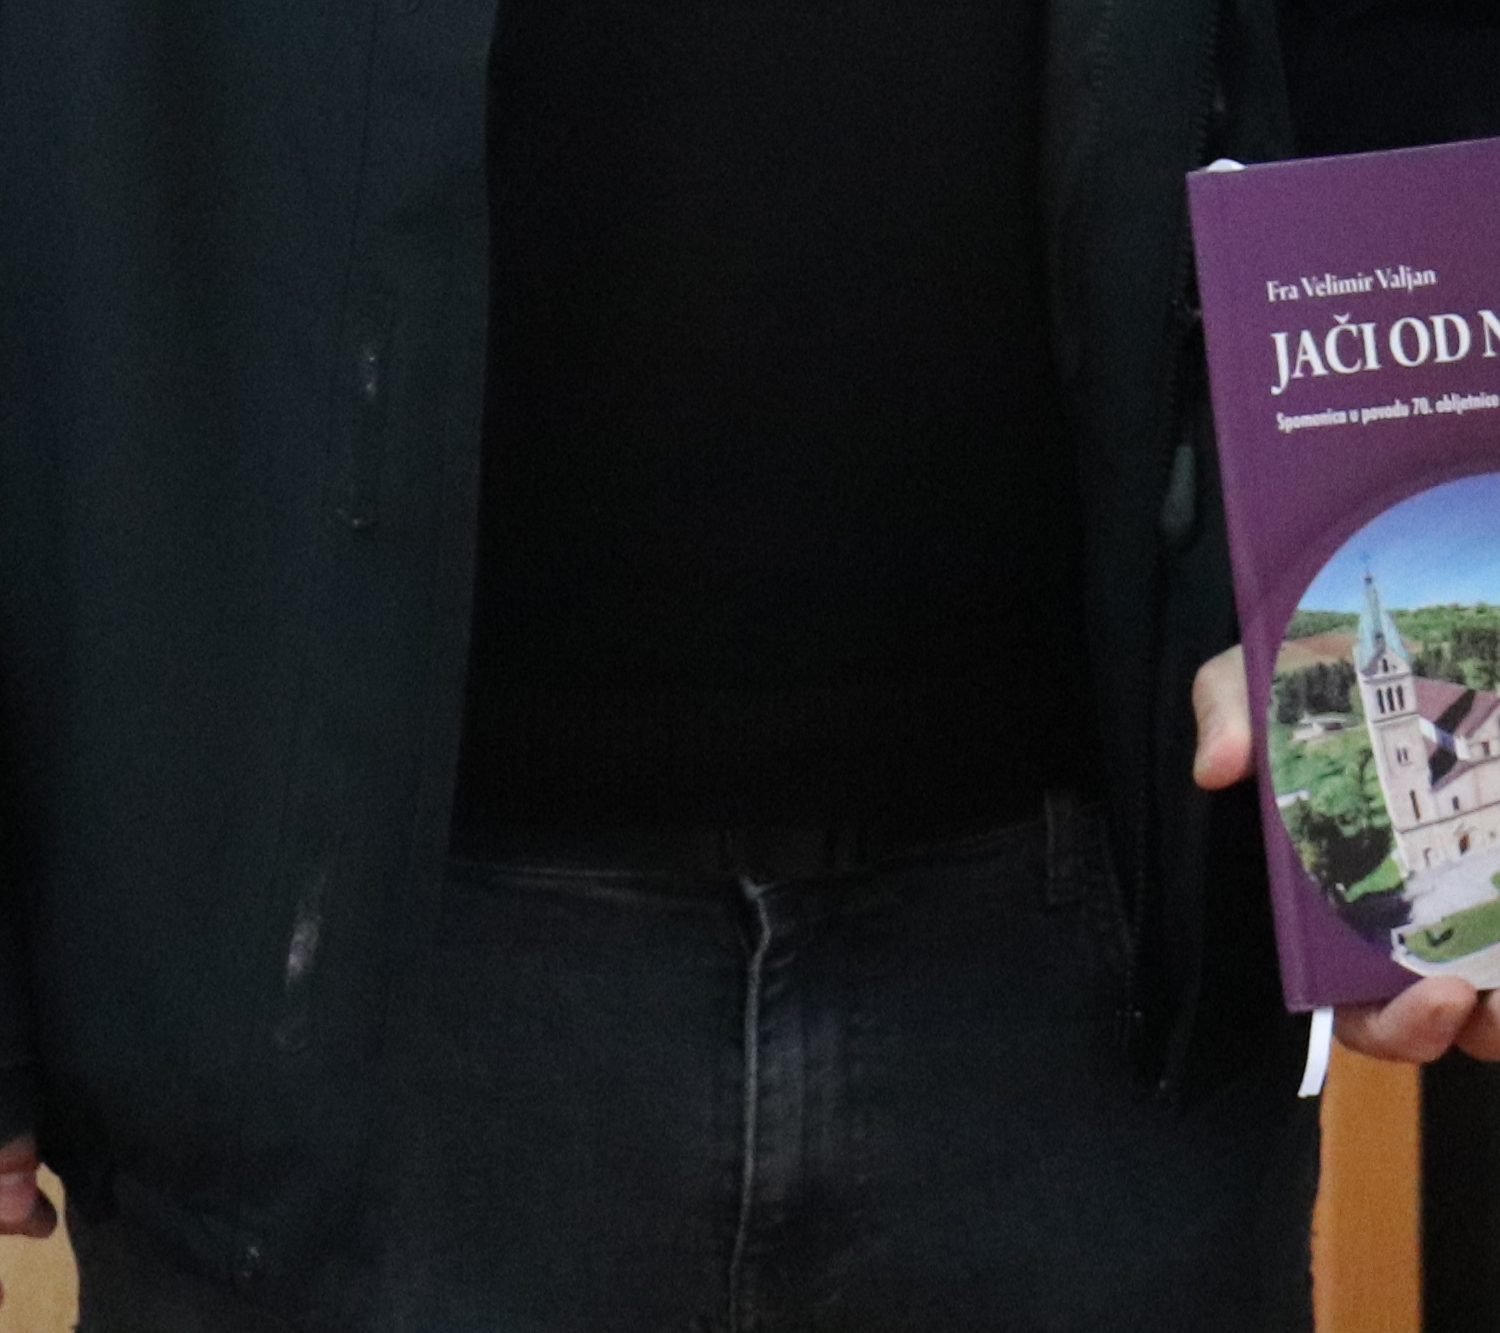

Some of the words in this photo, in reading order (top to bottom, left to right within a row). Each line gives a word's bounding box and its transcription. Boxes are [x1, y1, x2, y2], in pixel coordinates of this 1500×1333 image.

[1267, 280, 1299, 303] Fra
[1301, 272, 1374, 298] Velimir
[1374, 265, 1437, 294] Valjan
[1270, 312, 1383, 397] JAČI
[1389, 313, 1471, 367] OD
[1348, 407, 1360, 424] u
[1361, 398, 1409, 425] povodu
[1411, 396, 1434, 416] 70.
[1435, 391, 1500, 416] obljetnice
